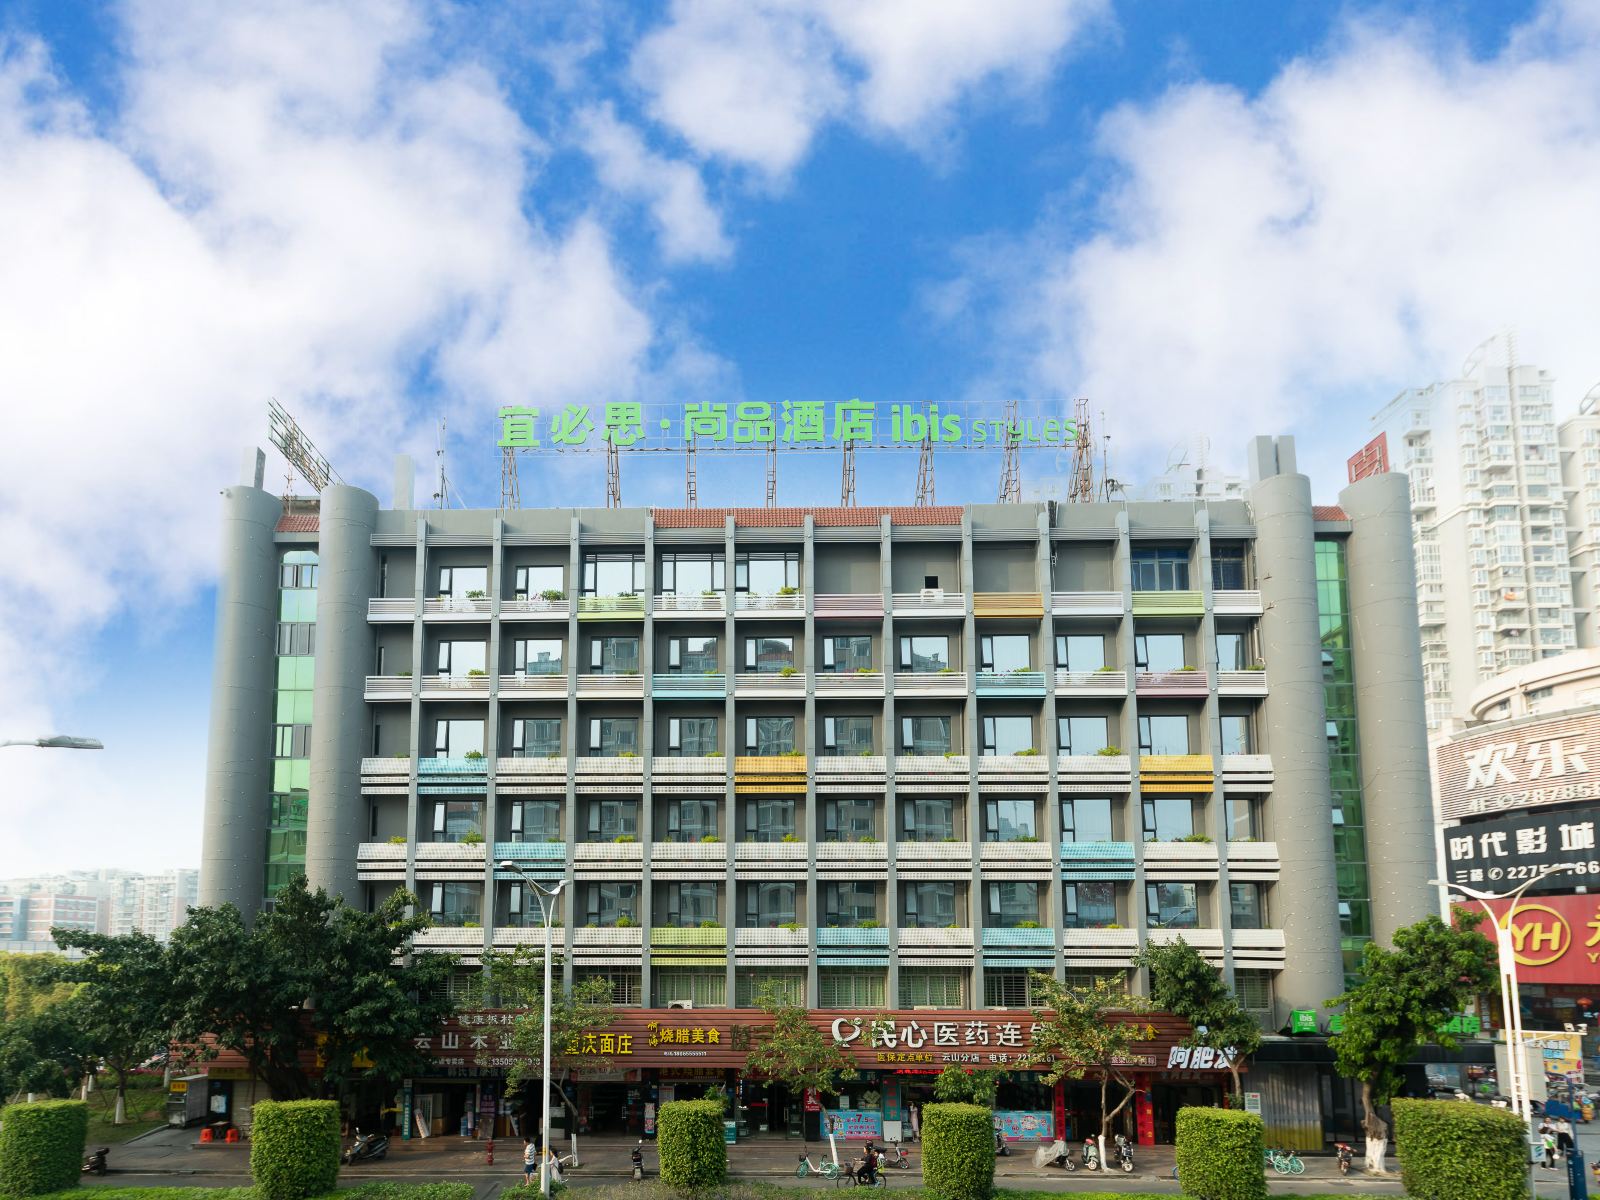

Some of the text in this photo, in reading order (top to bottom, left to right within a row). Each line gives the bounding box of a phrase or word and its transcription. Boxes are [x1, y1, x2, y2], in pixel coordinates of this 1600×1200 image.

[891, 404, 963, 443] ibis
[1449, 821, 1595, 861] 时代影城
[1511, 921, 1561, 951] YH
[659, 1027, 721, 1044] 烧腊美食
